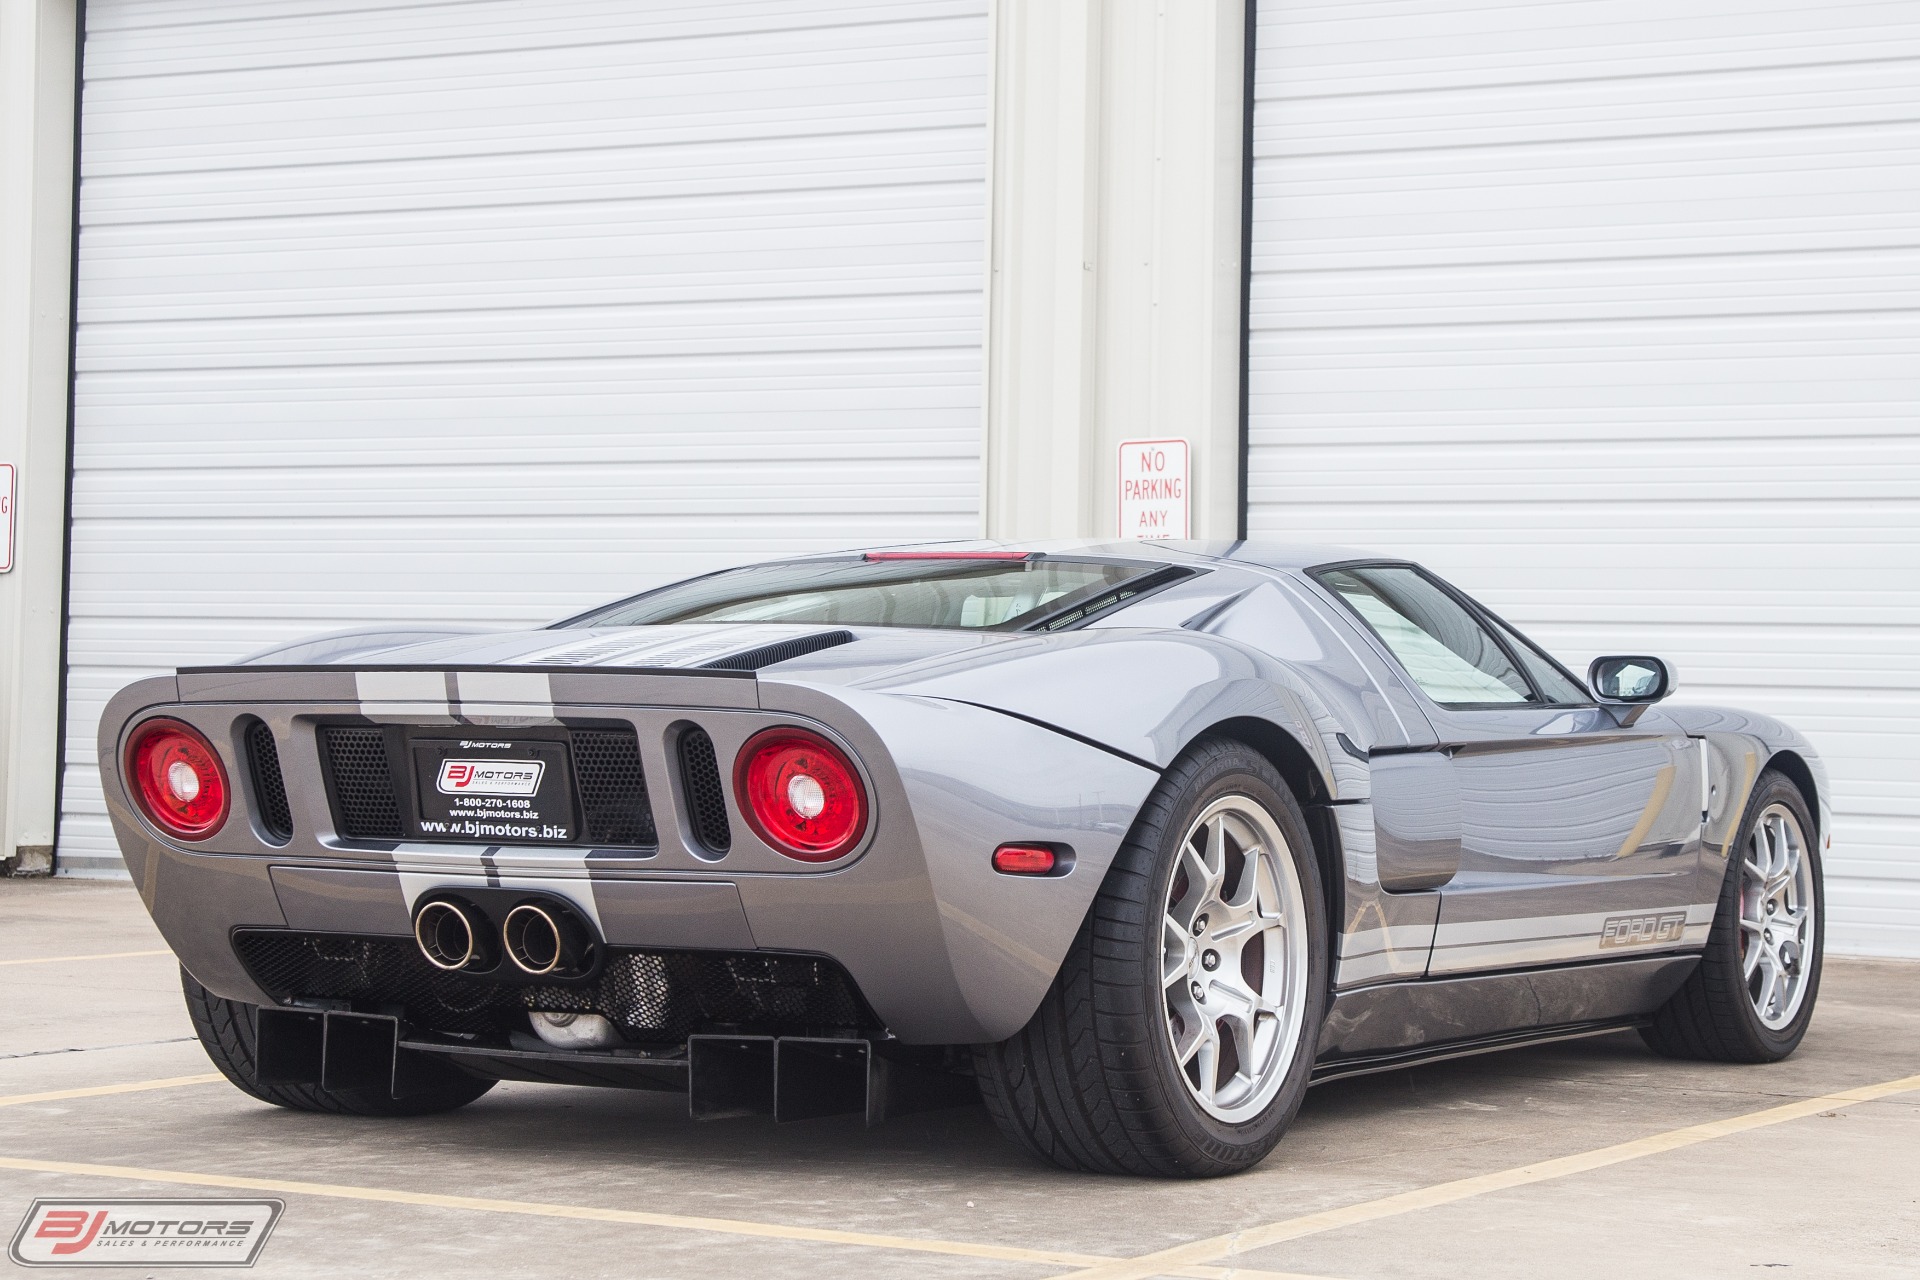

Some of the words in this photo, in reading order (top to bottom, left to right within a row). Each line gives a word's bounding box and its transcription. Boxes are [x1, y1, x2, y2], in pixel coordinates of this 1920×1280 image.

[1141, 451, 1165, 472] NO
[1125, 478, 1181, 500] PARKING
[1139, 510, 1168, 527] ANY
[459, 740, 473, 749] BJ
[447, 765, 475, 787] BJ
[474, 770, 533, 780] MOTORS
[453, 797, 531, 809] 1-800-270-1608
[449, 809, 539, 819] www.bjmotors.biz
[1601, 918, 1656, 944] FORD
[1657, 915, 1685, 939] GT
